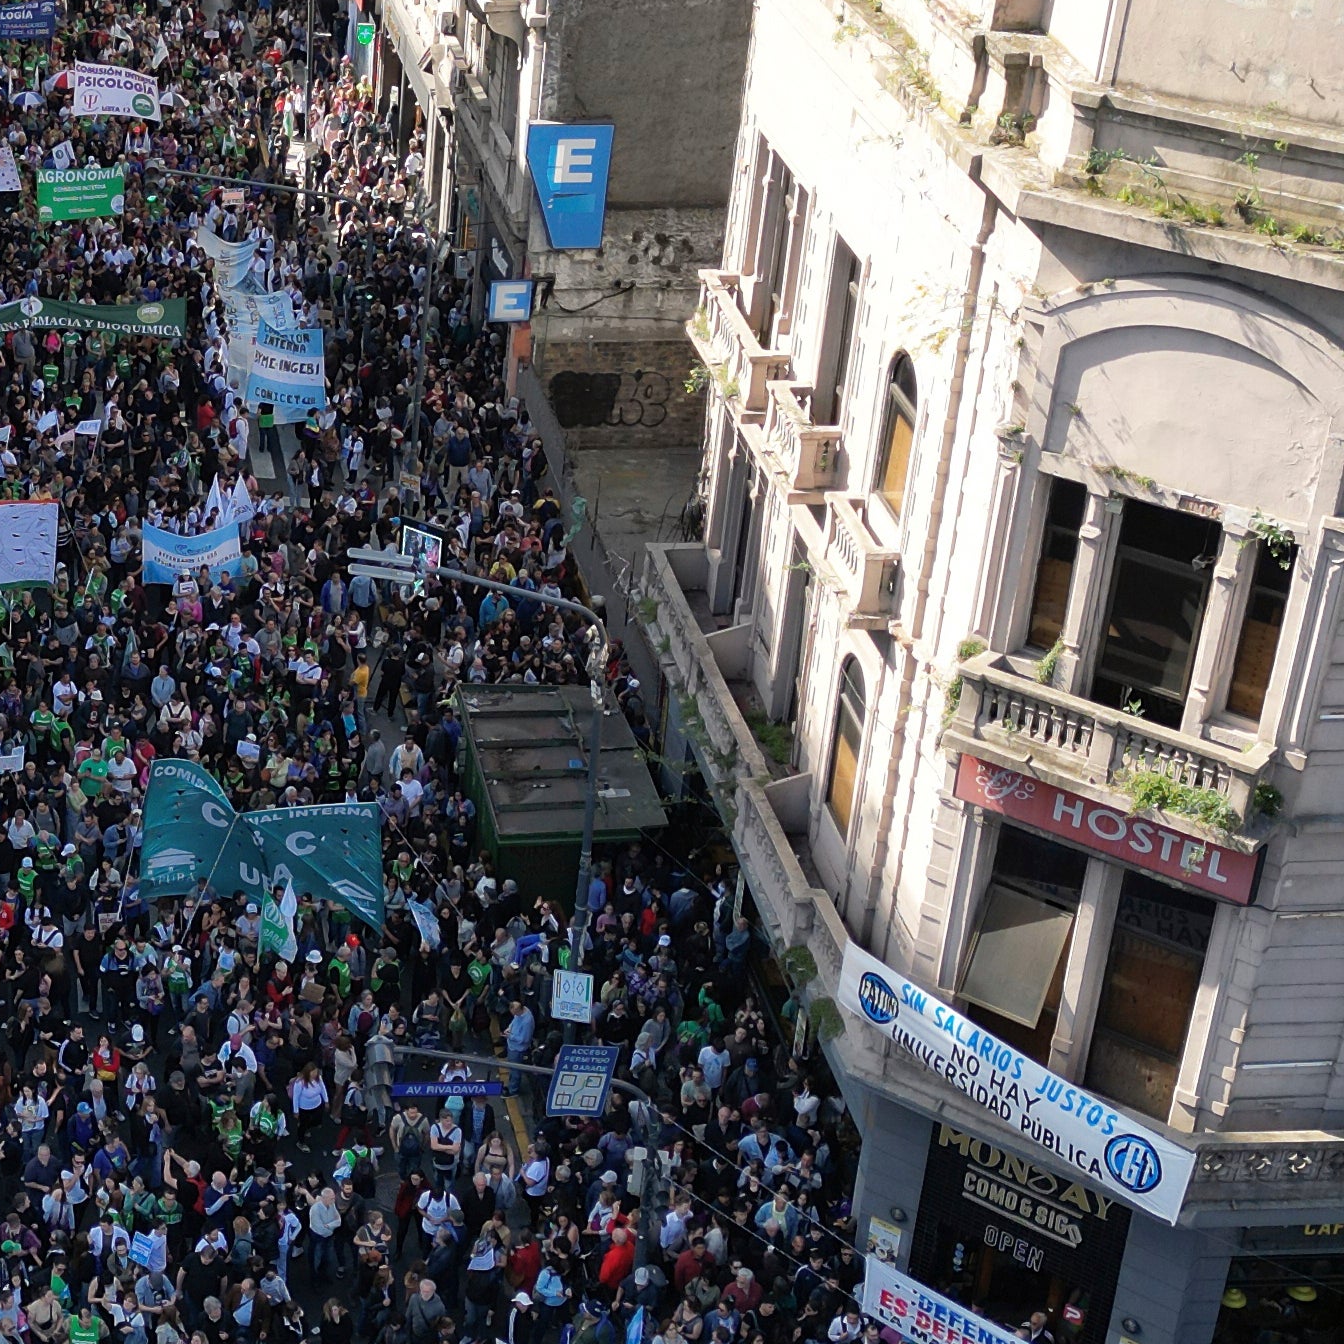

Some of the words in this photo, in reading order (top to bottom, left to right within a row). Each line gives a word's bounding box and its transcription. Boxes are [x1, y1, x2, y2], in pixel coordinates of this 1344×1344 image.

[553, 138, 596, 183] E
[493, 284, 527, 319] E
[84, 318, 94, 328] Y
[97, 320, 183, 337] BIOQUIMICA
[263, 334, 306, 353] INTERNA
[201, 802, 229, 827] C
[285, 831, 317, 856] C
[289, 807, 374, 818] INTERNA
[1053, 794, 1229, 884] HOSTEL
[571, 1048, 608, 1056] ACCESO
[899, 983, 927, 1016] SIN
[932, 1005, 1025, 1080] SALARIOS
[1034, 1074, 1120, 1137] JUSTOS
[406, 1085, 423, 1095] AV.
[426, 1084, 487, 1095] RIVADAVIA
[950, 1043, 980, 1077] NO
[989, 1068, 1041, 1114] HAY
[891, 1024, 1012, 1122] UNIVERSIDAD
[1020, 1108, 1105, 1181] PÚBLICA
[1114, 1138, 1157, 1189] CGT
[985, 1224, 1045, 1273] OPEN
[878, 1308, 904, 1328] LA
[879, 1289, 908, 1319] ES
